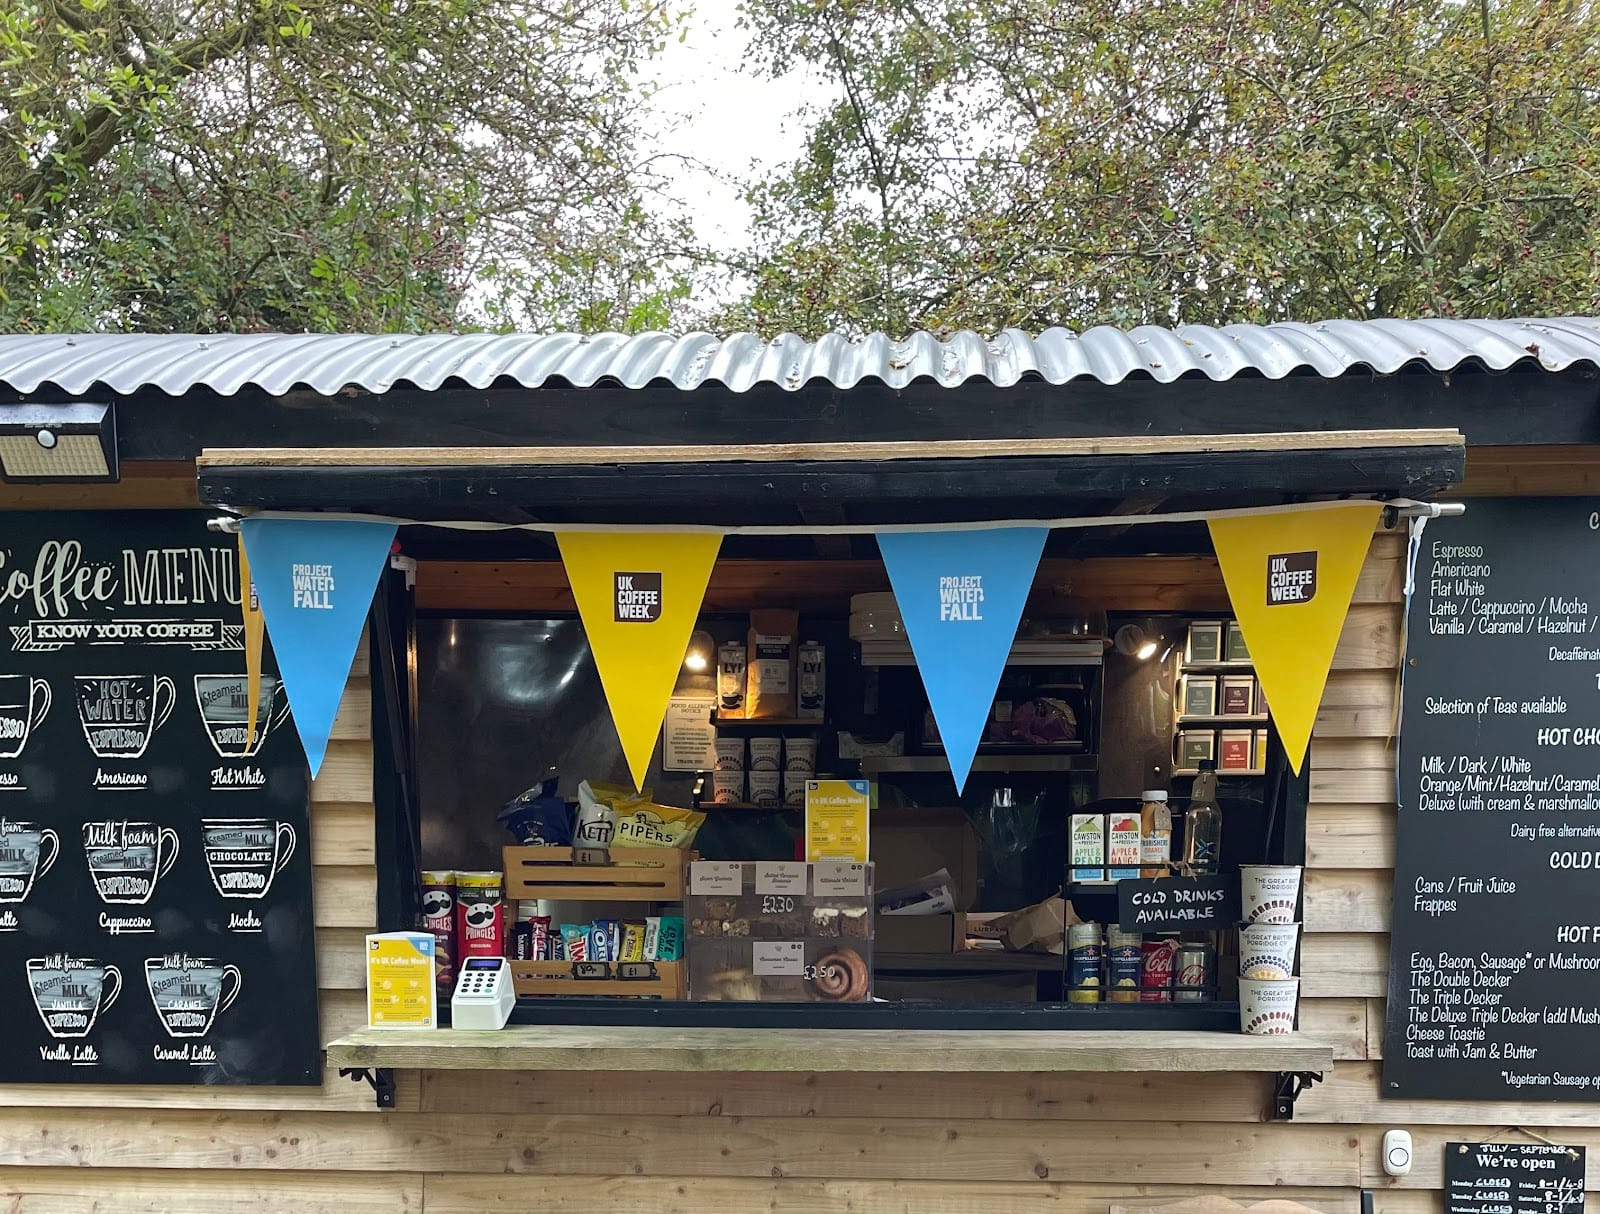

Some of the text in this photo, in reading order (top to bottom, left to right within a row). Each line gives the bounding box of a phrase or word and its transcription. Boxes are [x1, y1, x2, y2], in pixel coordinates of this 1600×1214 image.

[1432, 541, 1484, 563] Espresso
[292, 564, 333, 577] PROJECT
[1271, 557, 1288, 573] UK
[1431, 562, 1491, 578] Americano
[0, 541, 119, 617] offee
[292, 576, 335, 592] WATER
[618, 576, 633, 590] UK
[940, 575, 982, 588] PROJECT
[1270, 570, 1313, 587] COFFEE
[940, 587, 985, 603] WATER
[1430, 579, 1486, 597] Flat White
[293, 591, 334, 609] FALL
[617, 590, 658, 605] COFFEE
[941, 603, 983, 621] FALL
[1429, 596, 1588, 620] Latte Cappuccino Mocha
[37, 624, 214, 639] KNOW YOUR COFFEE
[1429, 616, 1587, 635] Vanilla Caramel Hazelnut
[84, 681, 147, 721] HOT WATER
[202, 683, 242, 706] Steamed
[1425, 696, 1568, 715] Selection of Teas available
[91, 728, 145, 748] ESPRESSO
[1537, 728, 1571, 746] HOT
[1421, 755, 1532, 774] Milk Dark White
[92, 767, 148, 786] Americano
[211, 766, 266, 785] Flat White
[1419, 793, 1537, 812] Deluxe (with cream &
[85, 819, 157, 850] Milk foam
[245, 833, 269, 847] MILK
[620, 822, 673, 843] PIPERS
[1074, 832, 1101, 840] CAWSTON
[1111, 832, 1139, 840] CAWSTON
[1510, 823, 1556, 841] Dairy free
[92, 850, 147, 869] Steamed MILK
[210, 851, 272, 862] CHOCOLATE
[1075, 848, 1101, 856] APPLE &
[1549, 851, 1592, 870] COLD
[99, 876, 150, 896] ESPRESSO
[219, 871, 266, 890] ESPRESSO
[1415, 876, 1517, 894] Cans Fruit Juice
[1132, 889, 1225, 905] COLD DRINKS
[1414, 895, 1457, 917] Frappes
[99, 912, 152, 935] Cappuccino
[227, 910, 262, 929] Mocha
[1135, 906, 1215, 924] AVAILABLE
[466, 926, 496, 941] PRINGLES
[1556, 926, 1591, 944] HOT
[43, 952, 87, 972] Milk foam
[162, 952, 206, 972] Milk foam
[1410, 952, 1435, 972] Egg,
[1439, 952, 1477, 971] Bacon,
[1534, 958, 1546, 970] or
[33, 974, 90, 998] Steamed MILK
[152, 973, 208, 998] Steamed MILK
[1410, 970, 1513, 988] The Double Decker
[1409, 988, 1503, 1009] The Triple Decker
[48, 1013, 88, 1028] ESPRESSO
[166, 1013, 206, 1028] ESPRESSO
[1408, 1006, 1430, 1023] The
[1431, 1006, 1467, 1024] Deluxe
[1470, 1006, 1499, 1028] Triple
[1501, 1006, 1541, 1025] Decker
[1543, 1006, 1568, 1025] (add
[1405, 1024, 1486, 1041] Cheese Toastie
[40, 1043, 99, 1061] Vanilla Latte
[154, 1043, 217, 1061] Caramel Latte
[1405, 1042, 1538, 1061] Toast with Jam & Butter
[1552, 1071, 1591, 1090] Sausage
[1479, 1144, 1567, 1155] JULY SEPTEMBER
[1475, 1154, 1556, 1172] We're open
[1475, 1178, 1511, 1187] CLOSED
[1474, 1190, 1510, 1200] CLOSED
[1481, 1204, 1513, 1213] CLOSED
